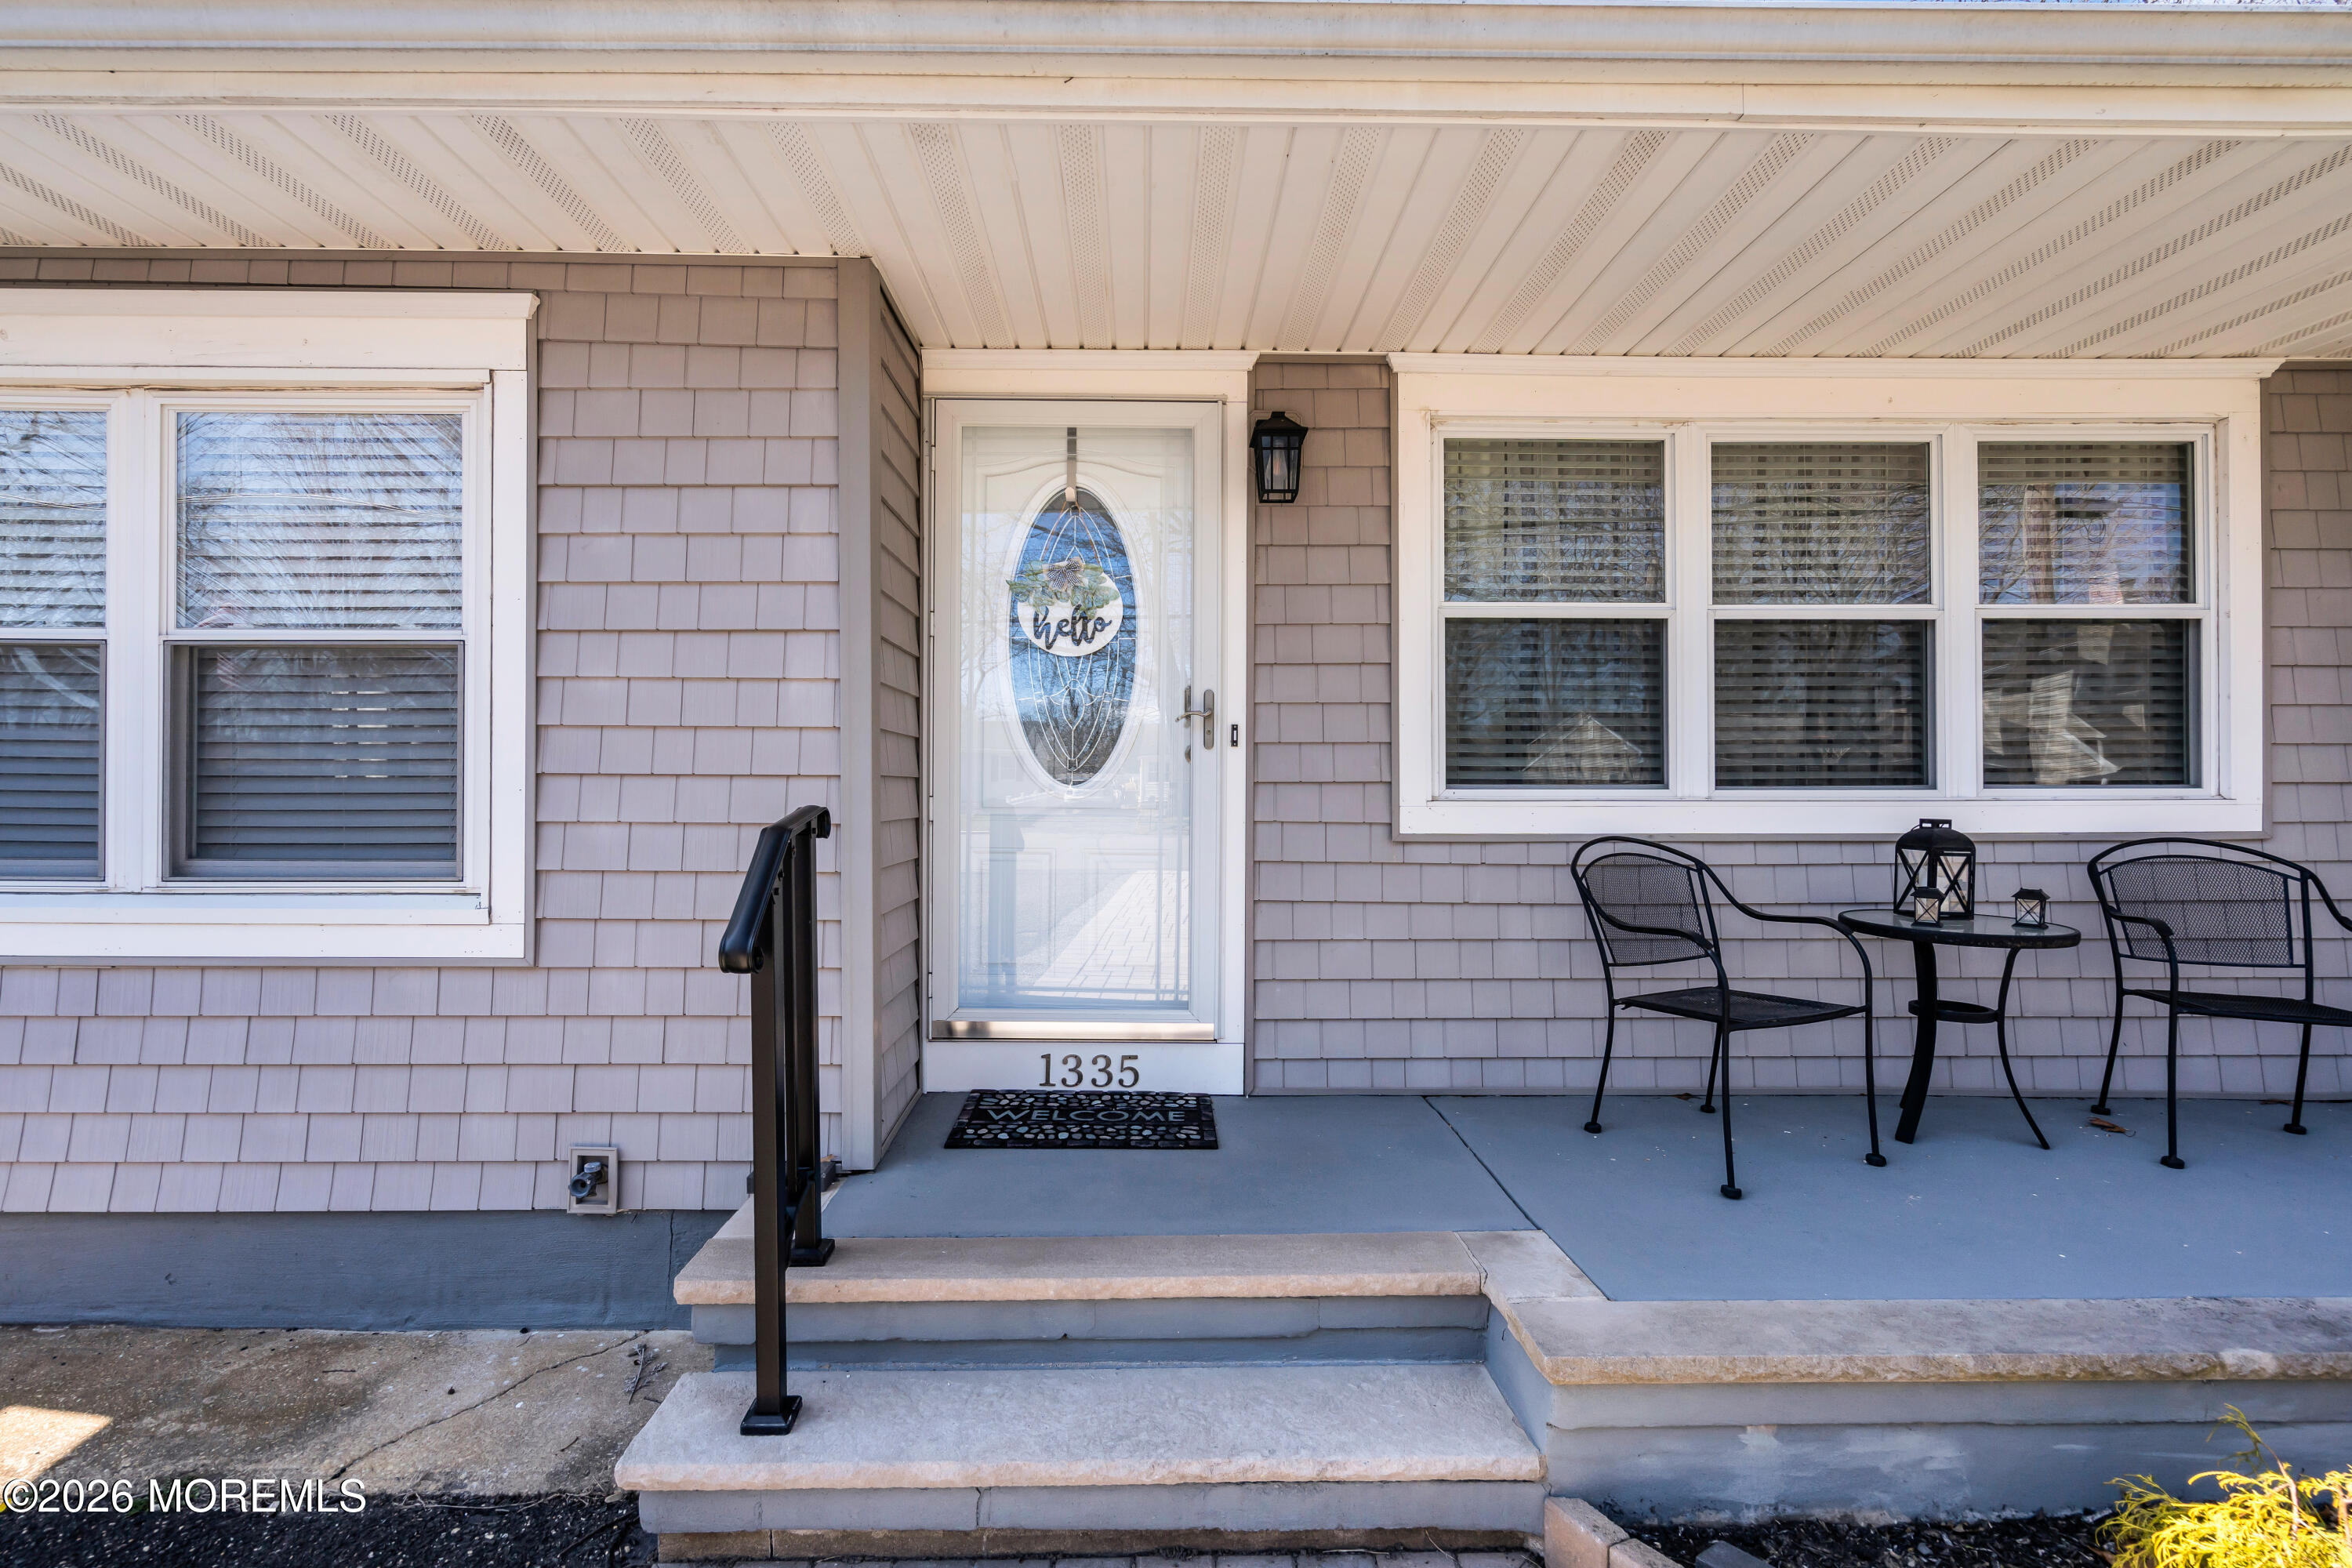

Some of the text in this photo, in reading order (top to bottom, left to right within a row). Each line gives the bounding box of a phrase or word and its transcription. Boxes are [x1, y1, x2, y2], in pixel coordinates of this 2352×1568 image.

[1033, 604, 1112, 650] hello
[1039, 1053, 1140, 1087] 1335
[987, 1109, 1186, 1123] WELCOME
